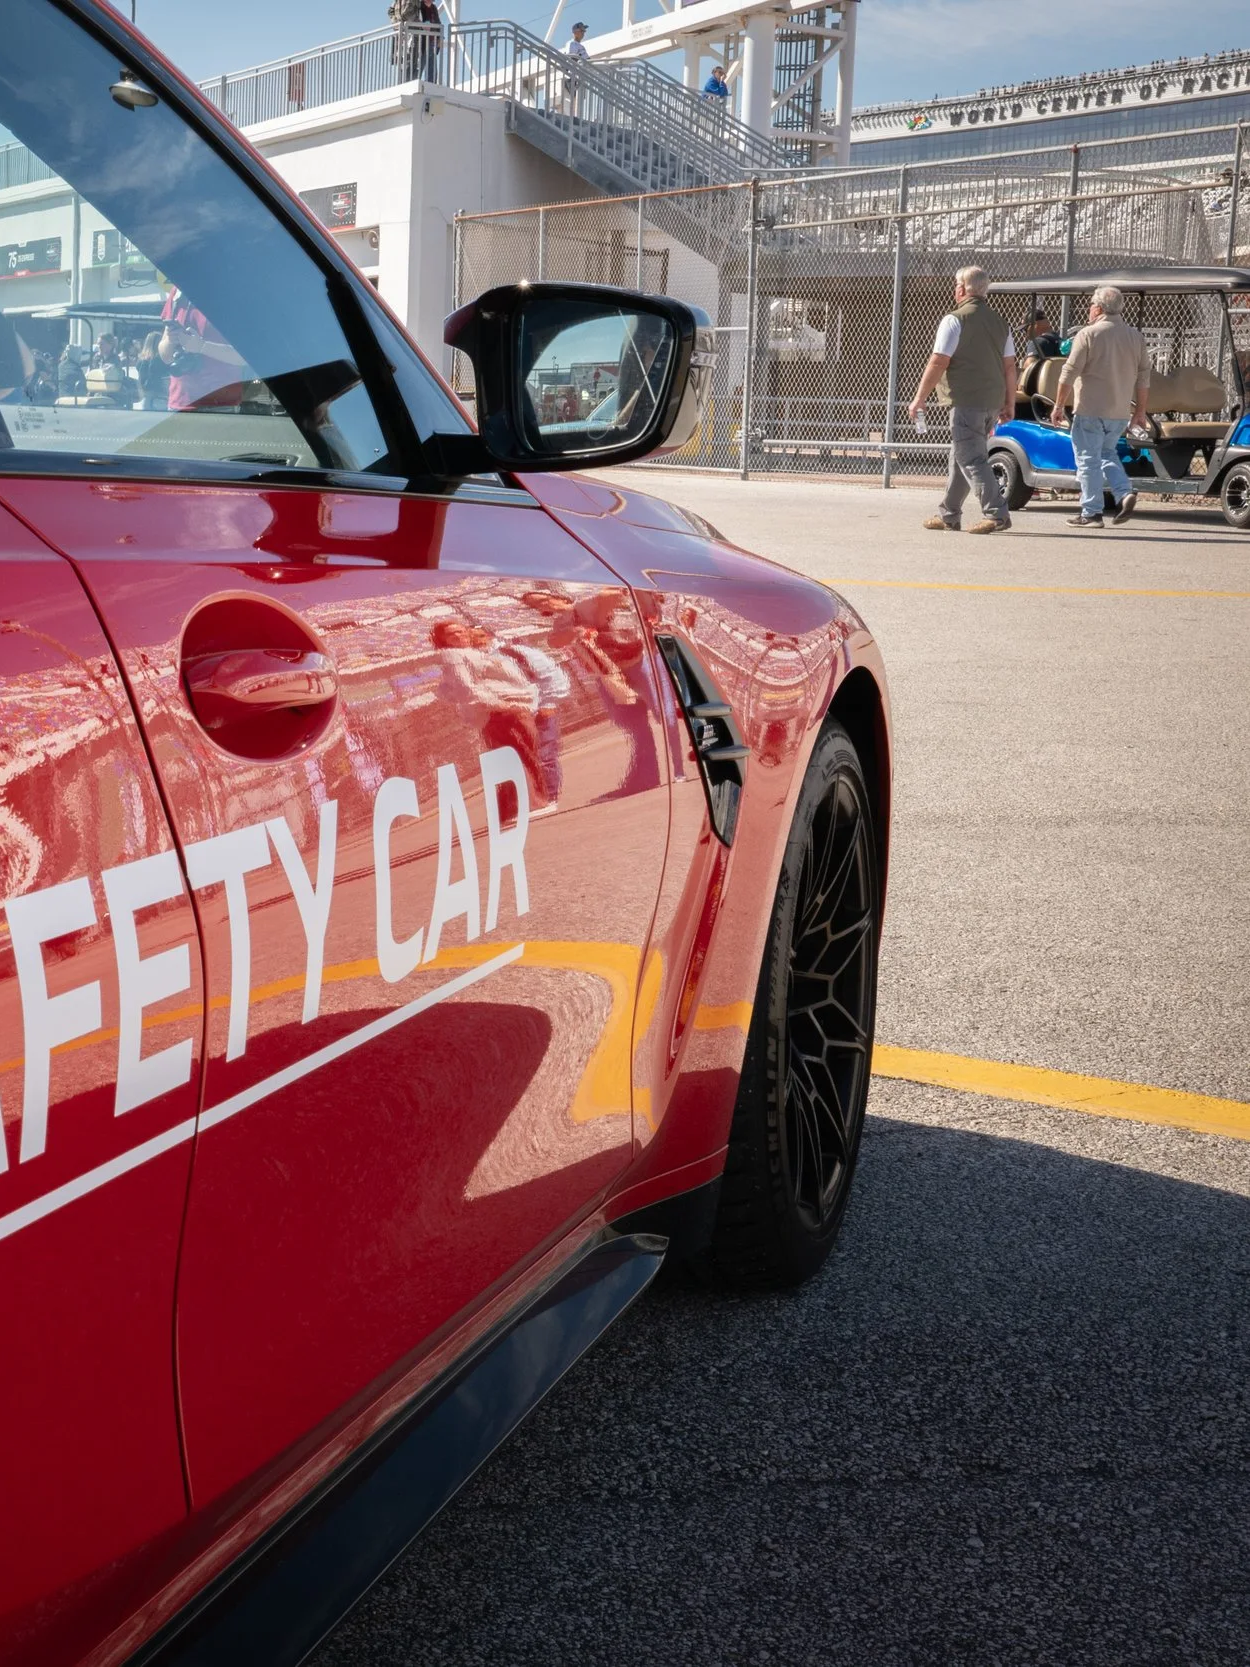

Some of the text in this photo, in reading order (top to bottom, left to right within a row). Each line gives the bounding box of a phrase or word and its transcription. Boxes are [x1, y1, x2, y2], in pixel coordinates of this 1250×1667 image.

[950, 103, 1023, 127] WORLD
[1037, 89, 1122, 115] CENTER
[1140, 81, 1167, 101] OF
[8, 251, 17, 268] 75
[372, 746, 530, 983] CAR
[767, 1035, 786, 1214] MICHELIN
